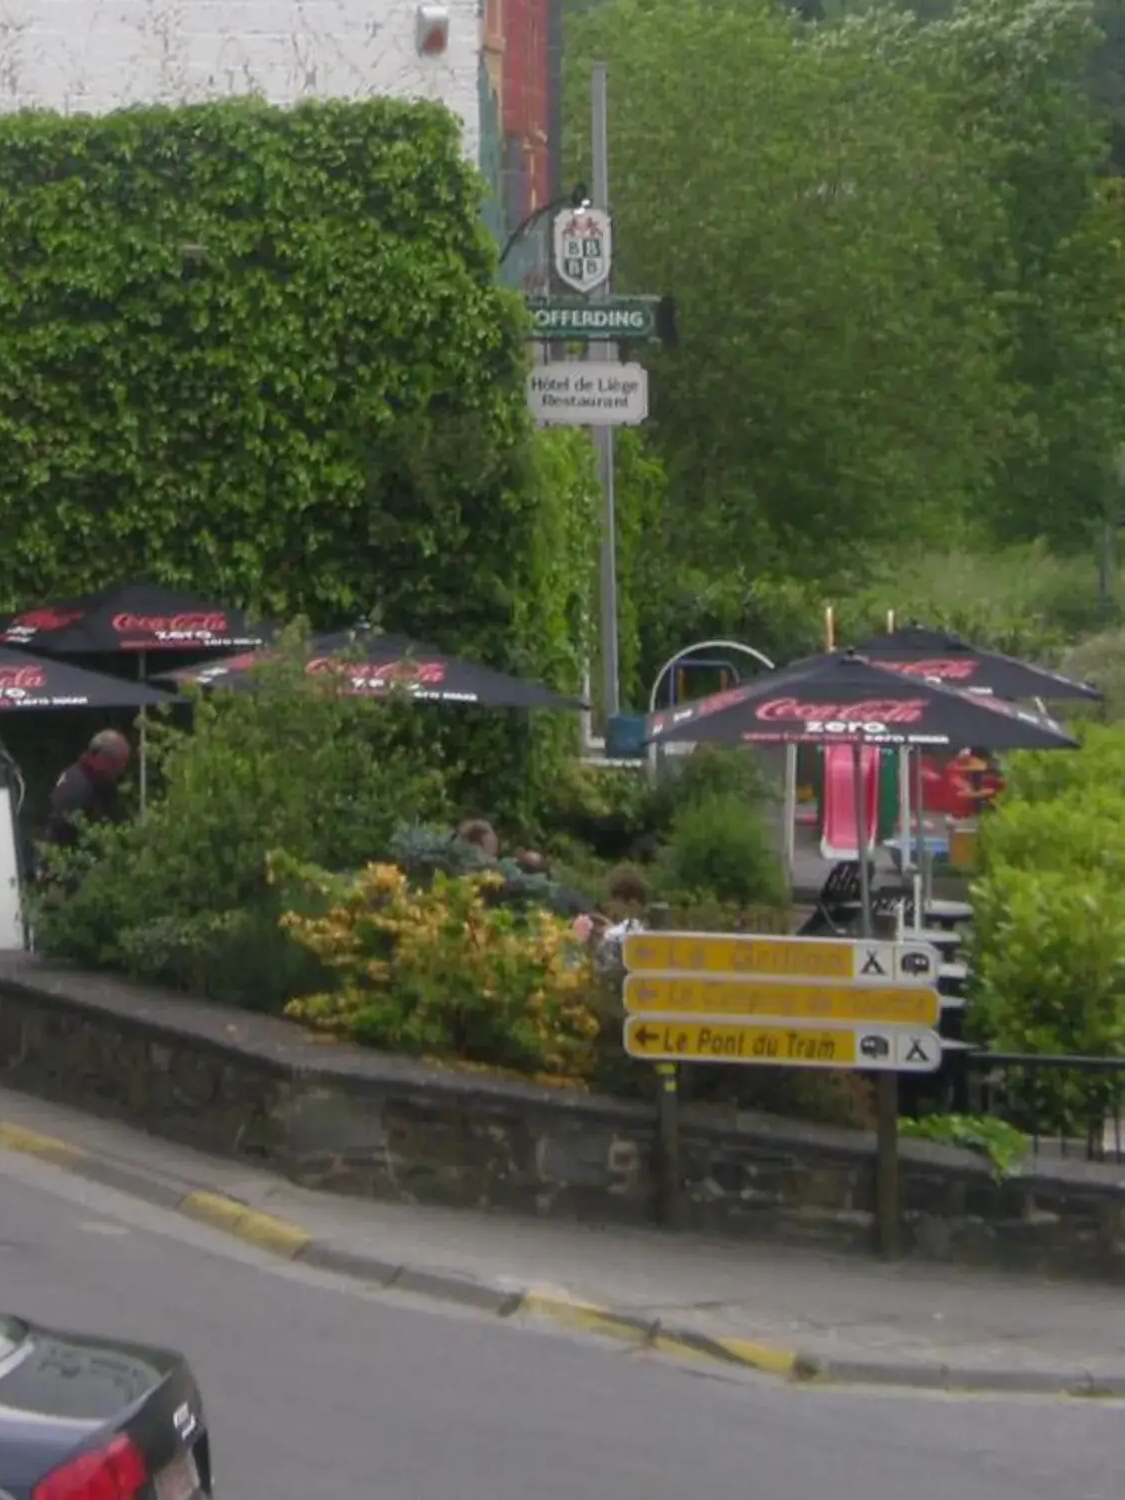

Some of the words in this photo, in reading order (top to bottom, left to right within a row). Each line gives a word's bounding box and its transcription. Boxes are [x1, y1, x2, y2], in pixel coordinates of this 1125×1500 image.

[532, 308, 644, 328] OFFERDING
[574, 377, 594, 392] de
[756, 698, 927, 722] Coca-Cola
[806, 721, 886, 734] zero
[662, 1027, 688, 1052] Le
[696, 1028, 745, 1055] Pont
[752, 1031, 777, 1056] du
[786, 1032, 836, 1059] Tram
